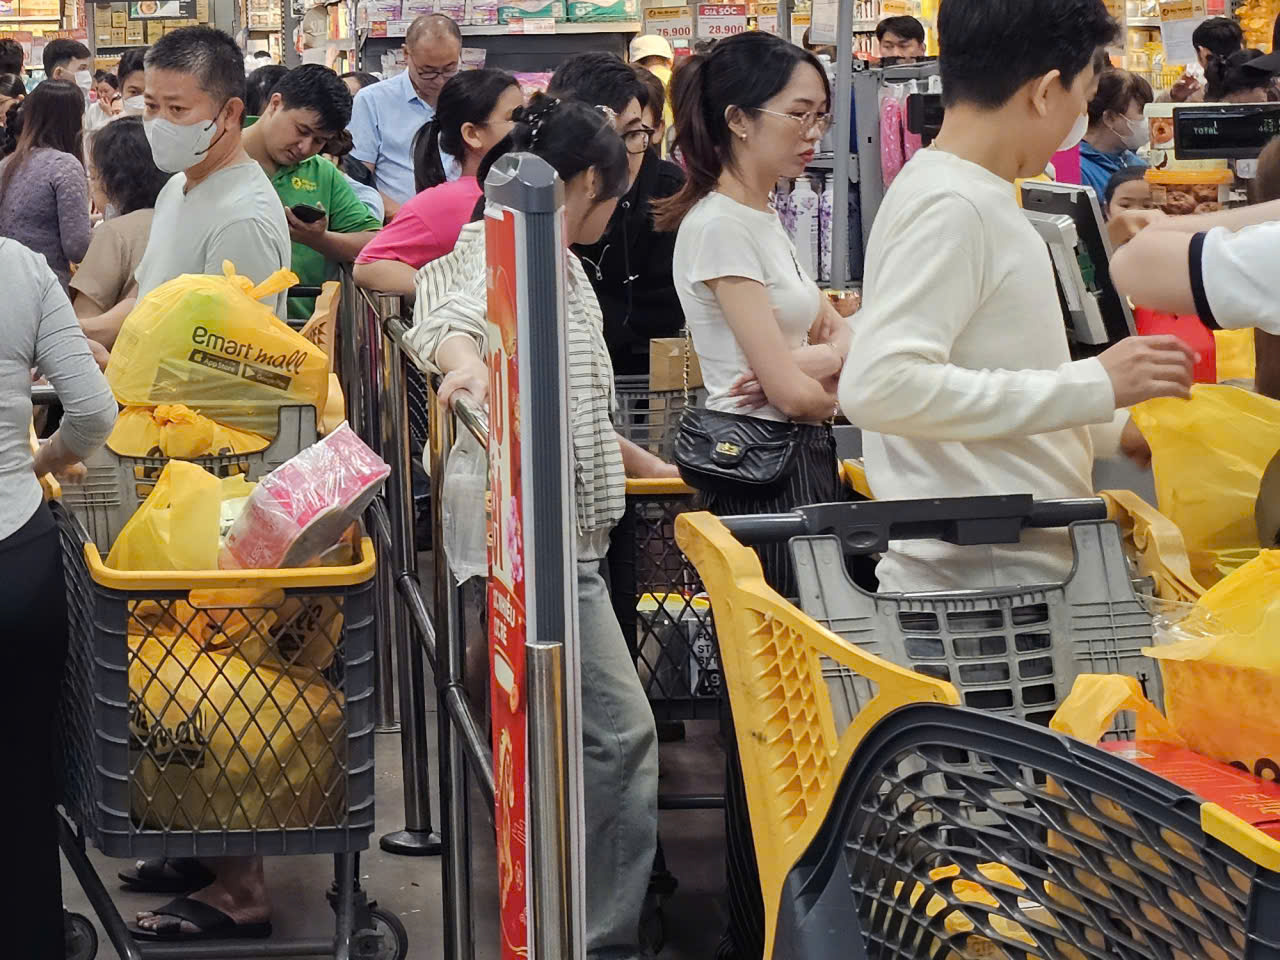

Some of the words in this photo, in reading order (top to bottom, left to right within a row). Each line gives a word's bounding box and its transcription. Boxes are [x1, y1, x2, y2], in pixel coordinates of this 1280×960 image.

[708, 24, 744, 35] 28.900
[192, 326, 253, 360] emart
[254, 348, 308, 375] mall
